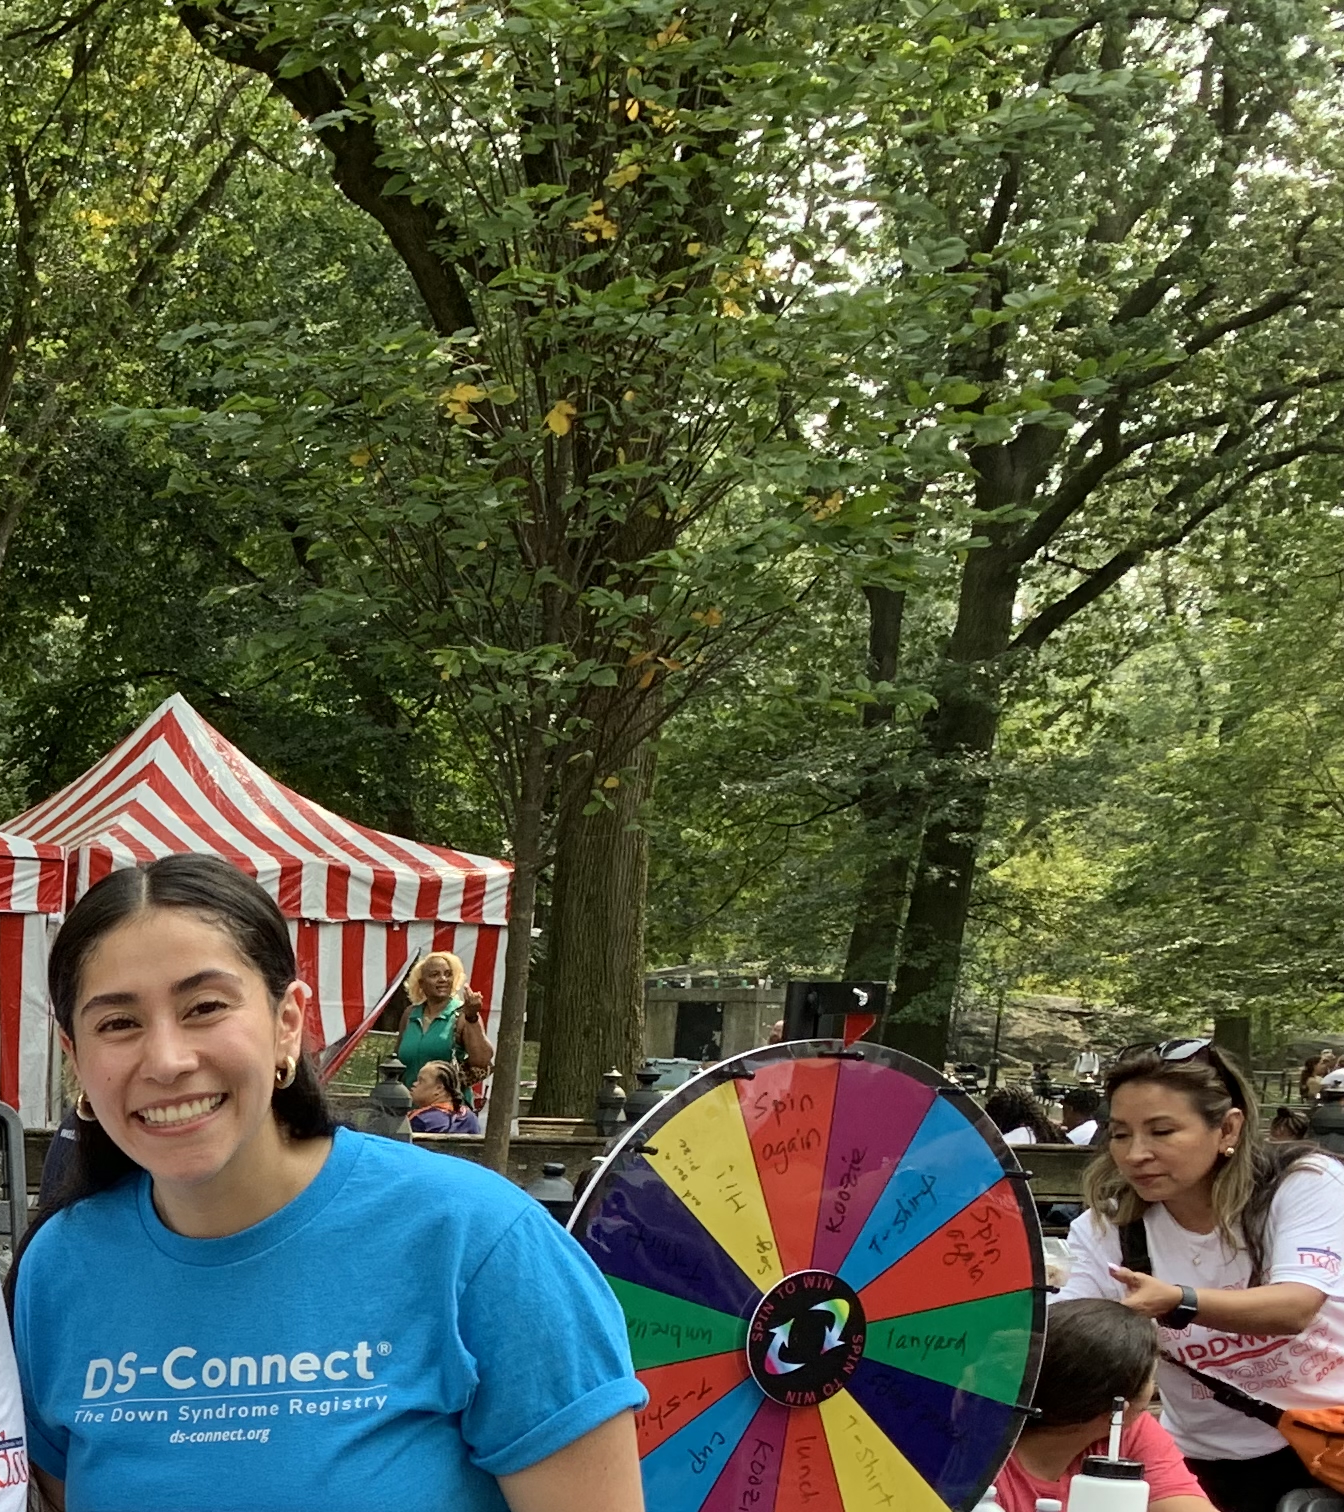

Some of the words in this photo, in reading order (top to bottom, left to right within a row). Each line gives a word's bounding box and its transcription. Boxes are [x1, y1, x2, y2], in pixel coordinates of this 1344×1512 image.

[761, 1127, 822, 1176] again
[752, 1302, 775, 1342] SPIN
[775, 1281, 797, 1300] TO
[802, 1274, 835, 1292] WIN
[842, 1334, 863, 1375] SPIN
[886, 1327, 967, 1362] lanyard
[785, 1389, 816, 1405] WIN
[822, 1377, 843, 1396] TO
[74, 1409, 105, 1424] The
[111, 1406, 168, 1423] Down
[178, 1400, 280, 1424] Syndrome
[289, 1394, 388, 1417] Registry
[169, 1426, 271, 1444] ds-connect.org
